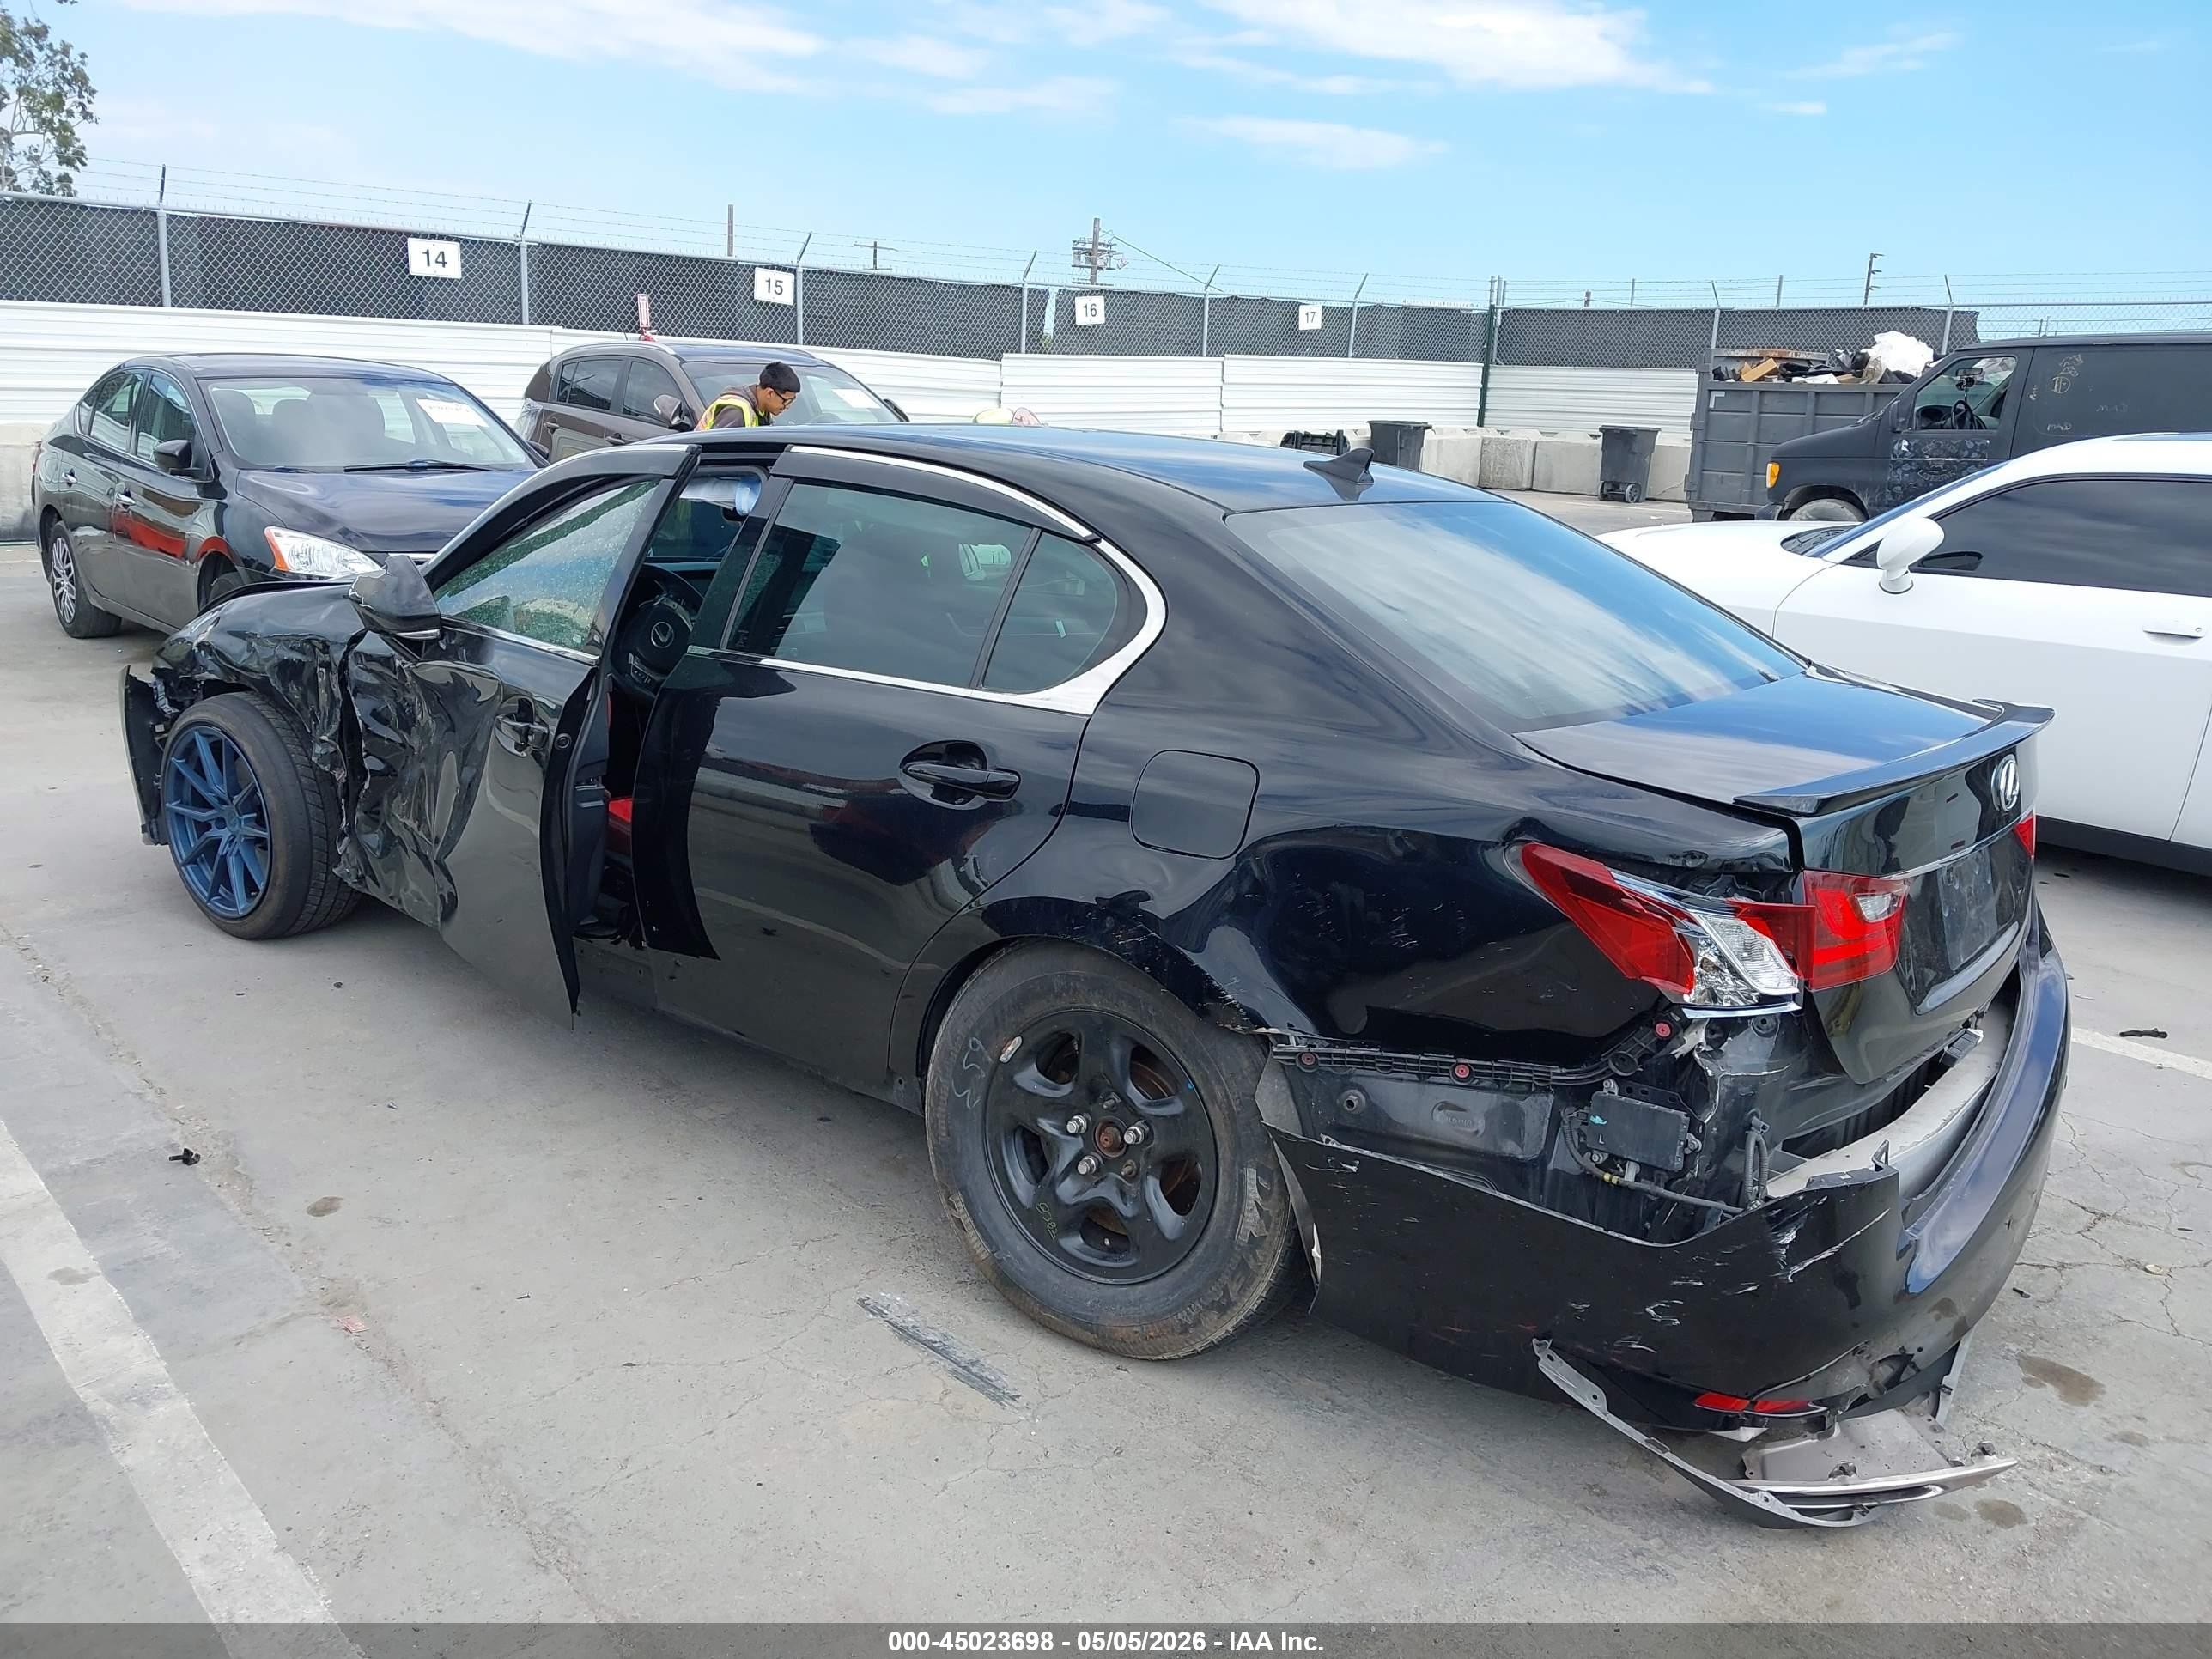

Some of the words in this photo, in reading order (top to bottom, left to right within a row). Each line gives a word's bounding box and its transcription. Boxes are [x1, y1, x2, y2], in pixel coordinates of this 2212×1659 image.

[422, 249, 447, 268] 14
[765, 277, 783, 295] 15
[1083, 303, 1097, 317] 16
[1305, 311, 1316, 323] 17
